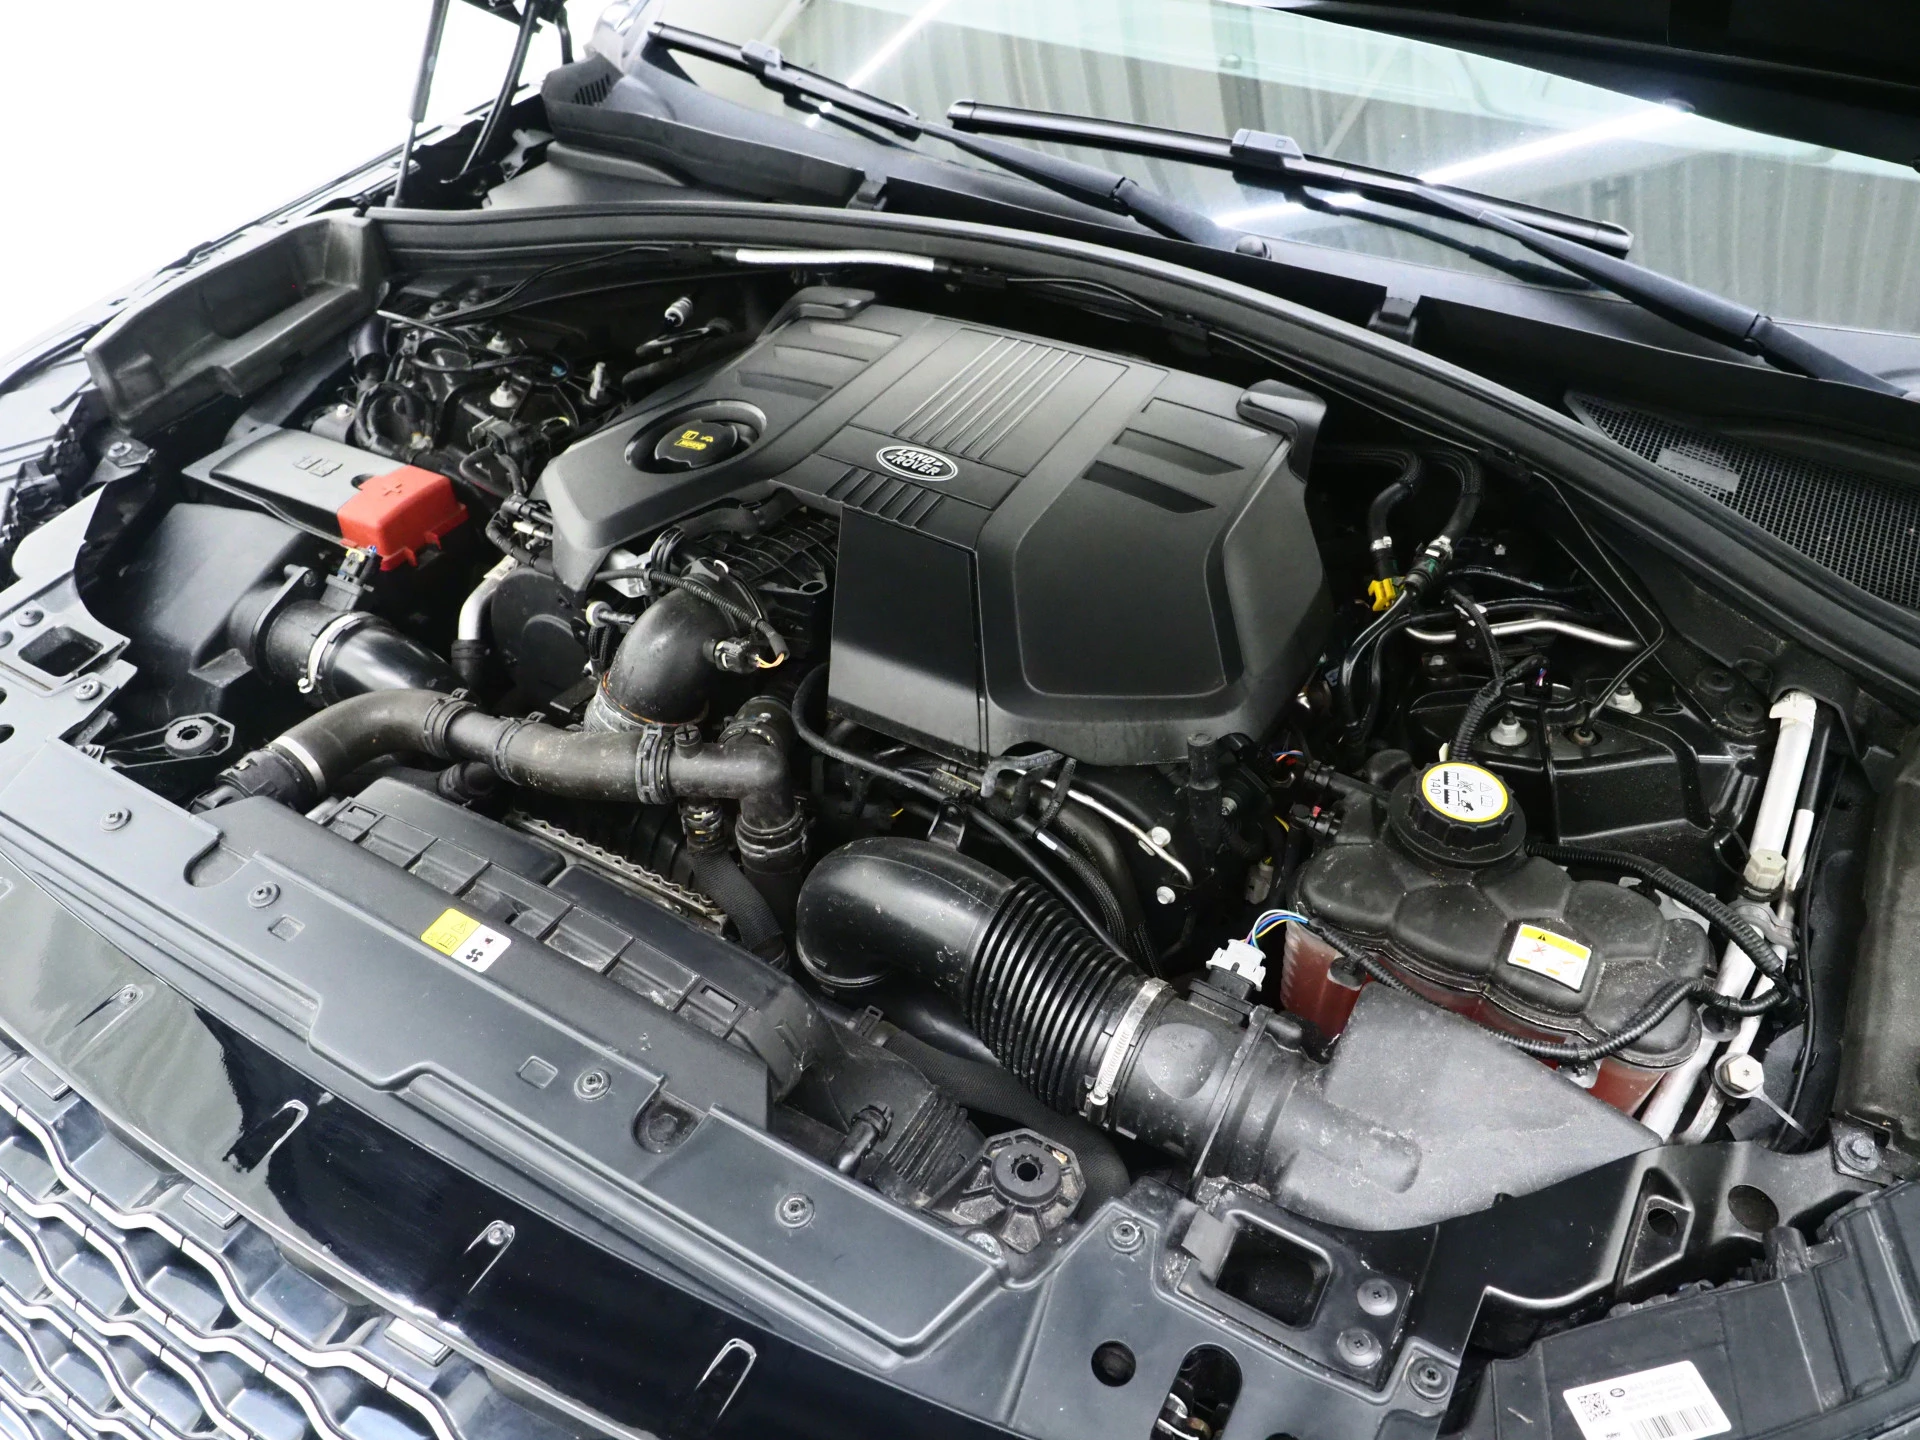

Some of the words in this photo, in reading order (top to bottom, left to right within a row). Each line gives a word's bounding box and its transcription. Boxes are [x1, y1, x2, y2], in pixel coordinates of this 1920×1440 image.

[896, 449, 936, 464] LAND
[892, 456, 941, 475] ROVER
[1430, 778, 1441, 794] 140
